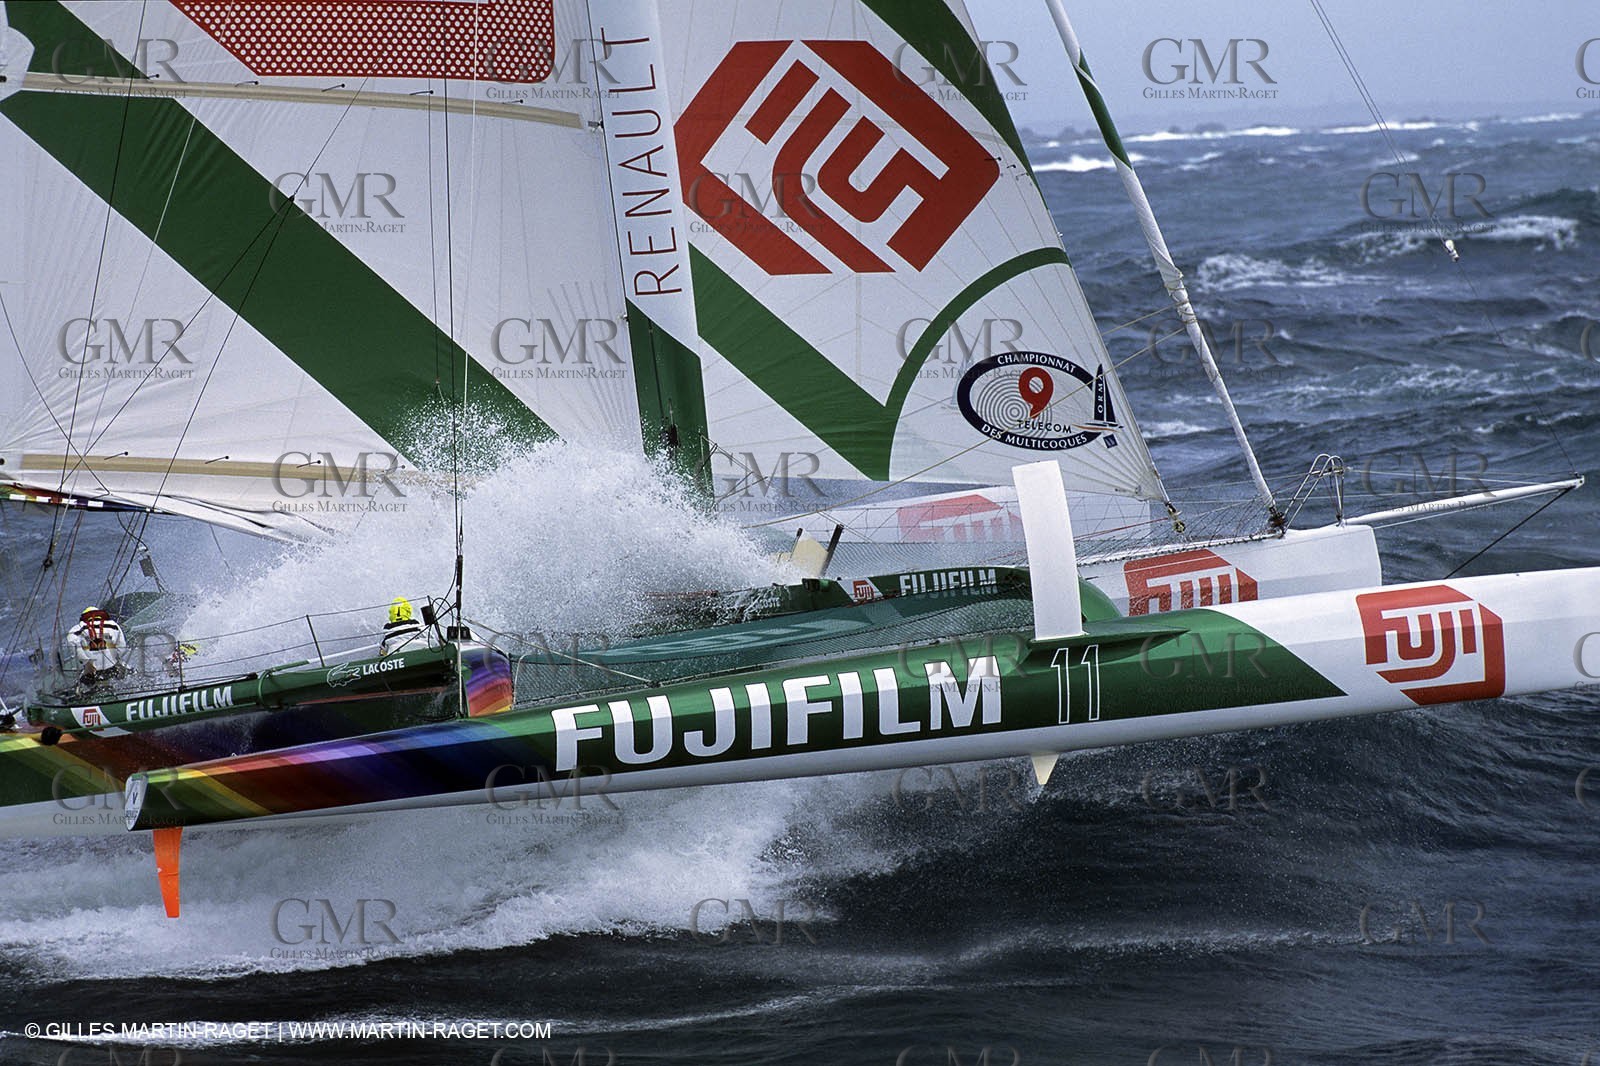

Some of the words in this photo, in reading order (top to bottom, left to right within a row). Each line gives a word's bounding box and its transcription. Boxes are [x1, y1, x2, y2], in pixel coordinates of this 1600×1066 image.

[601, 27, 682, 296] RENAULT
[997, 353, 1076, 373] CHAMPIONNAT
[981, 423, 1002, 440] DES
[1005, 434, 1088, 450] MULTICOQUES
[1016, 419, 1072, 434] TELECOM
[900, 568, 998, 597] FUJIFILM
[1368, 595, 1492, 698] FUJI
[363, 658, 405, 676] LACOSTE
[1050, 644, 1101, 725] 11
[125, 686, 234, 722] FUJIFILM
[551, 655, 1002, 773] FUJIFILM
